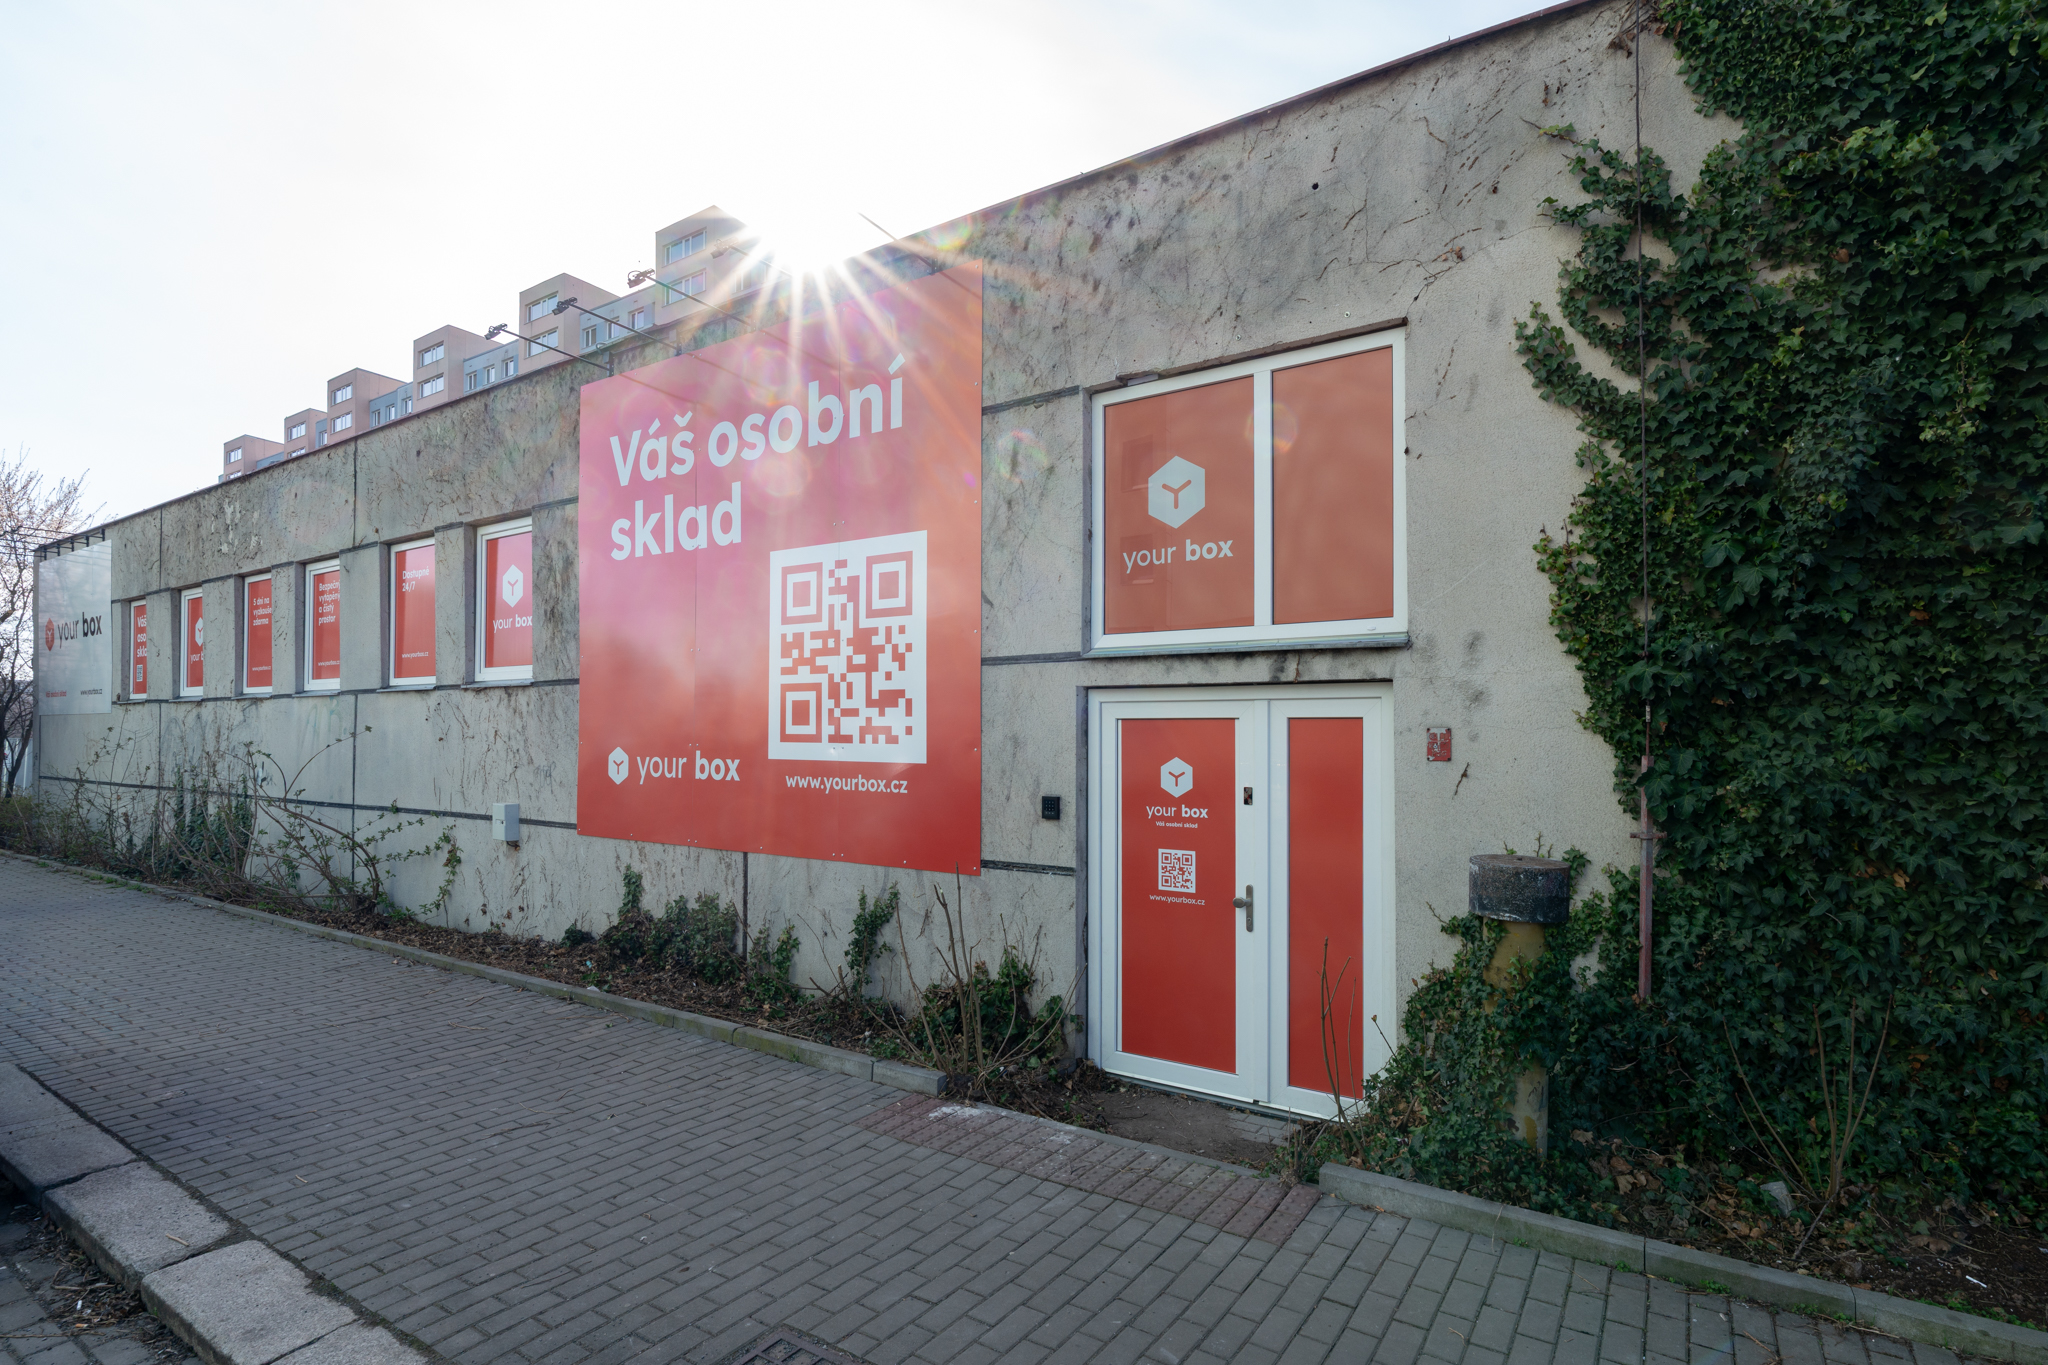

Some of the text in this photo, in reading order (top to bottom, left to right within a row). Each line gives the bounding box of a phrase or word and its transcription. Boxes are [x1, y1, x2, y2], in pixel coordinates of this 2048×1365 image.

[610, 352, 906, 487] Váš osobní
[610, 481, 742, 561] sklad
[1122, 538, 1234, 574] your box
[402, 566, 430, 580] Dostupné
[402, 581, 416, 592] 24/7
[57, 611, 102, 649] your box
[492, 614, 532, 633] your box
[137, 633, 147, 643] oso
[137, 645, 147, 658] skla
[190, 653, 200, 664] your
[636, 750, 740, 785] your box
[785, 774, 908, 794] www.yourbox.cz
[1146, 804, 1209, 819] your box
[1149, 894, 1206, 906] www.yourbox.cz
